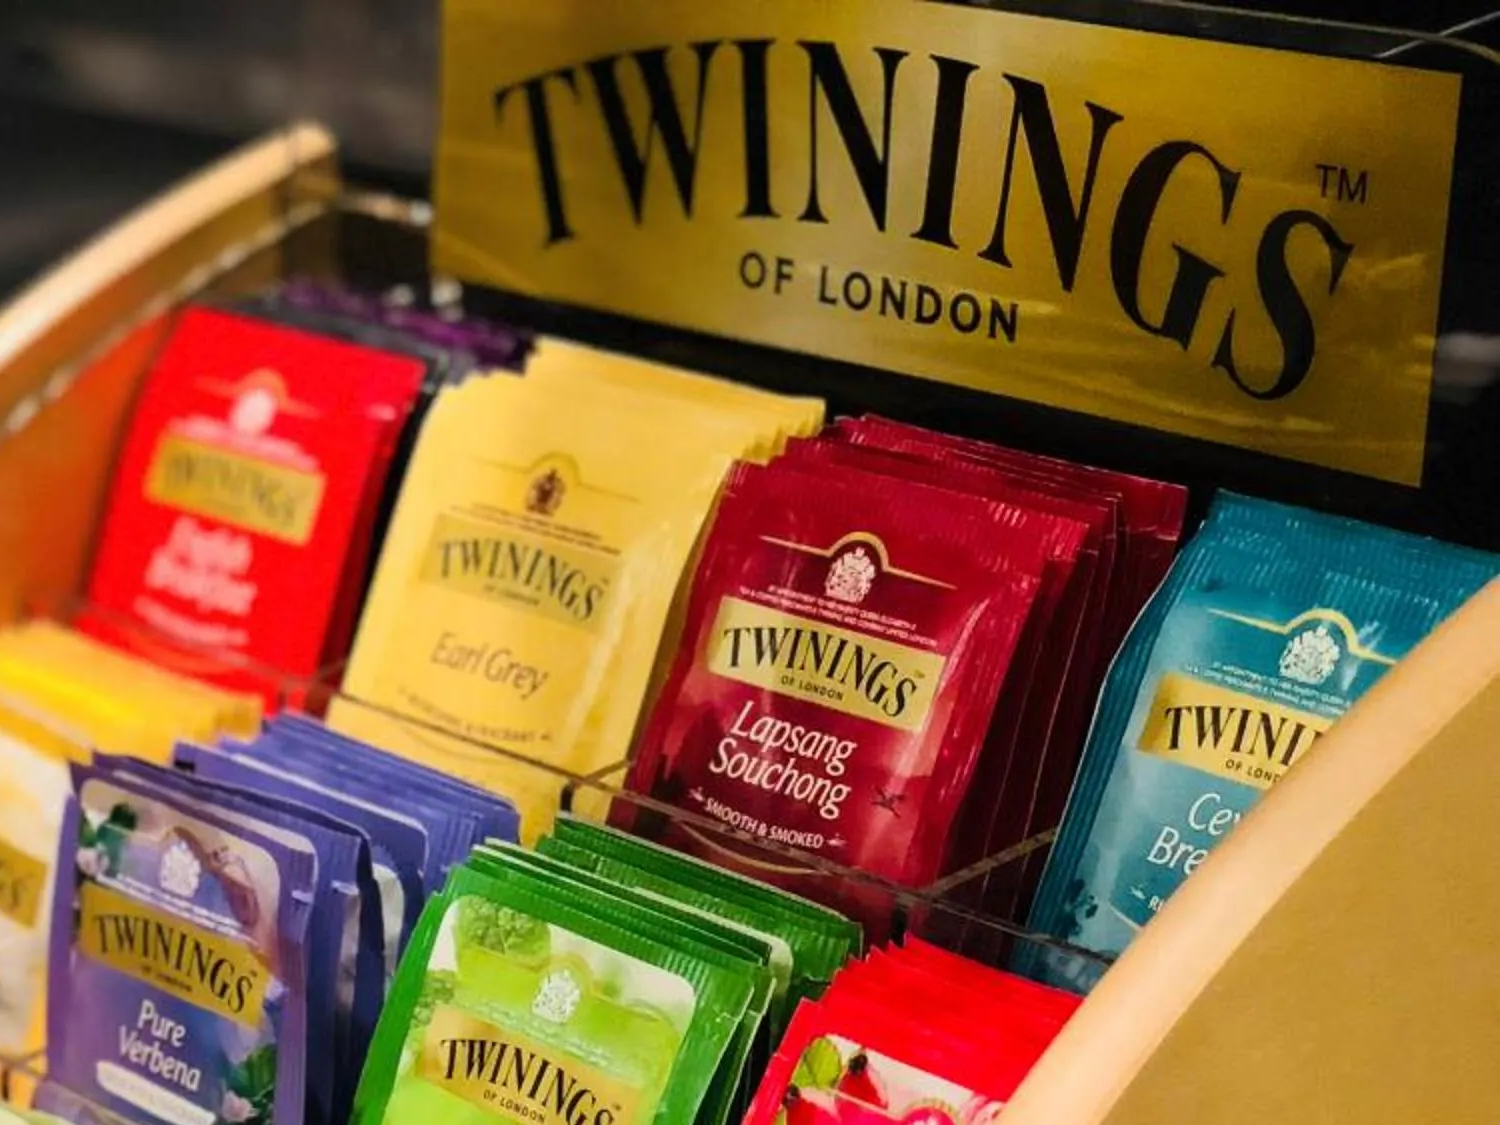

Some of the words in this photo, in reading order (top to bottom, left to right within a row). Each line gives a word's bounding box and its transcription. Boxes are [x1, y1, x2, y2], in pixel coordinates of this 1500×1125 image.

[1315, 163, 1368, 205] TM
[494, 38, 1355, 400] TWININGS
[739, 251, 795, 295] OF
[817, 264, 1019, 342] LONDON
[438, 537, 604, 622] TWININGS
[430, 631, 489, 675] Earl
[483, 646, 551, 702] Grey
[723, 626, 918, 718] TWININGS
[780, 675, 795, 687] OF
[799, 679, 845, 702] LONDON
[730, 699, 859, 776] Lapsang
[1164, 704, 1323, 768] TWINI
[1225, 758, 1243, 772] OF
[708, 737, 853, 820] Souchong
[704, 797, 757, 834] SMOOTH
[756, 822, 768, 837] &
[768, 824, 825, 849] SMOKED
[93, 914, 253, 1014] TWININGS
[118, 1024, 202, 1092] Verbena
[137, 999, 186, 1048] Pure
[483, 1089, 498, 1102] OF
[499, 1096, 546, 1125] LONDON
